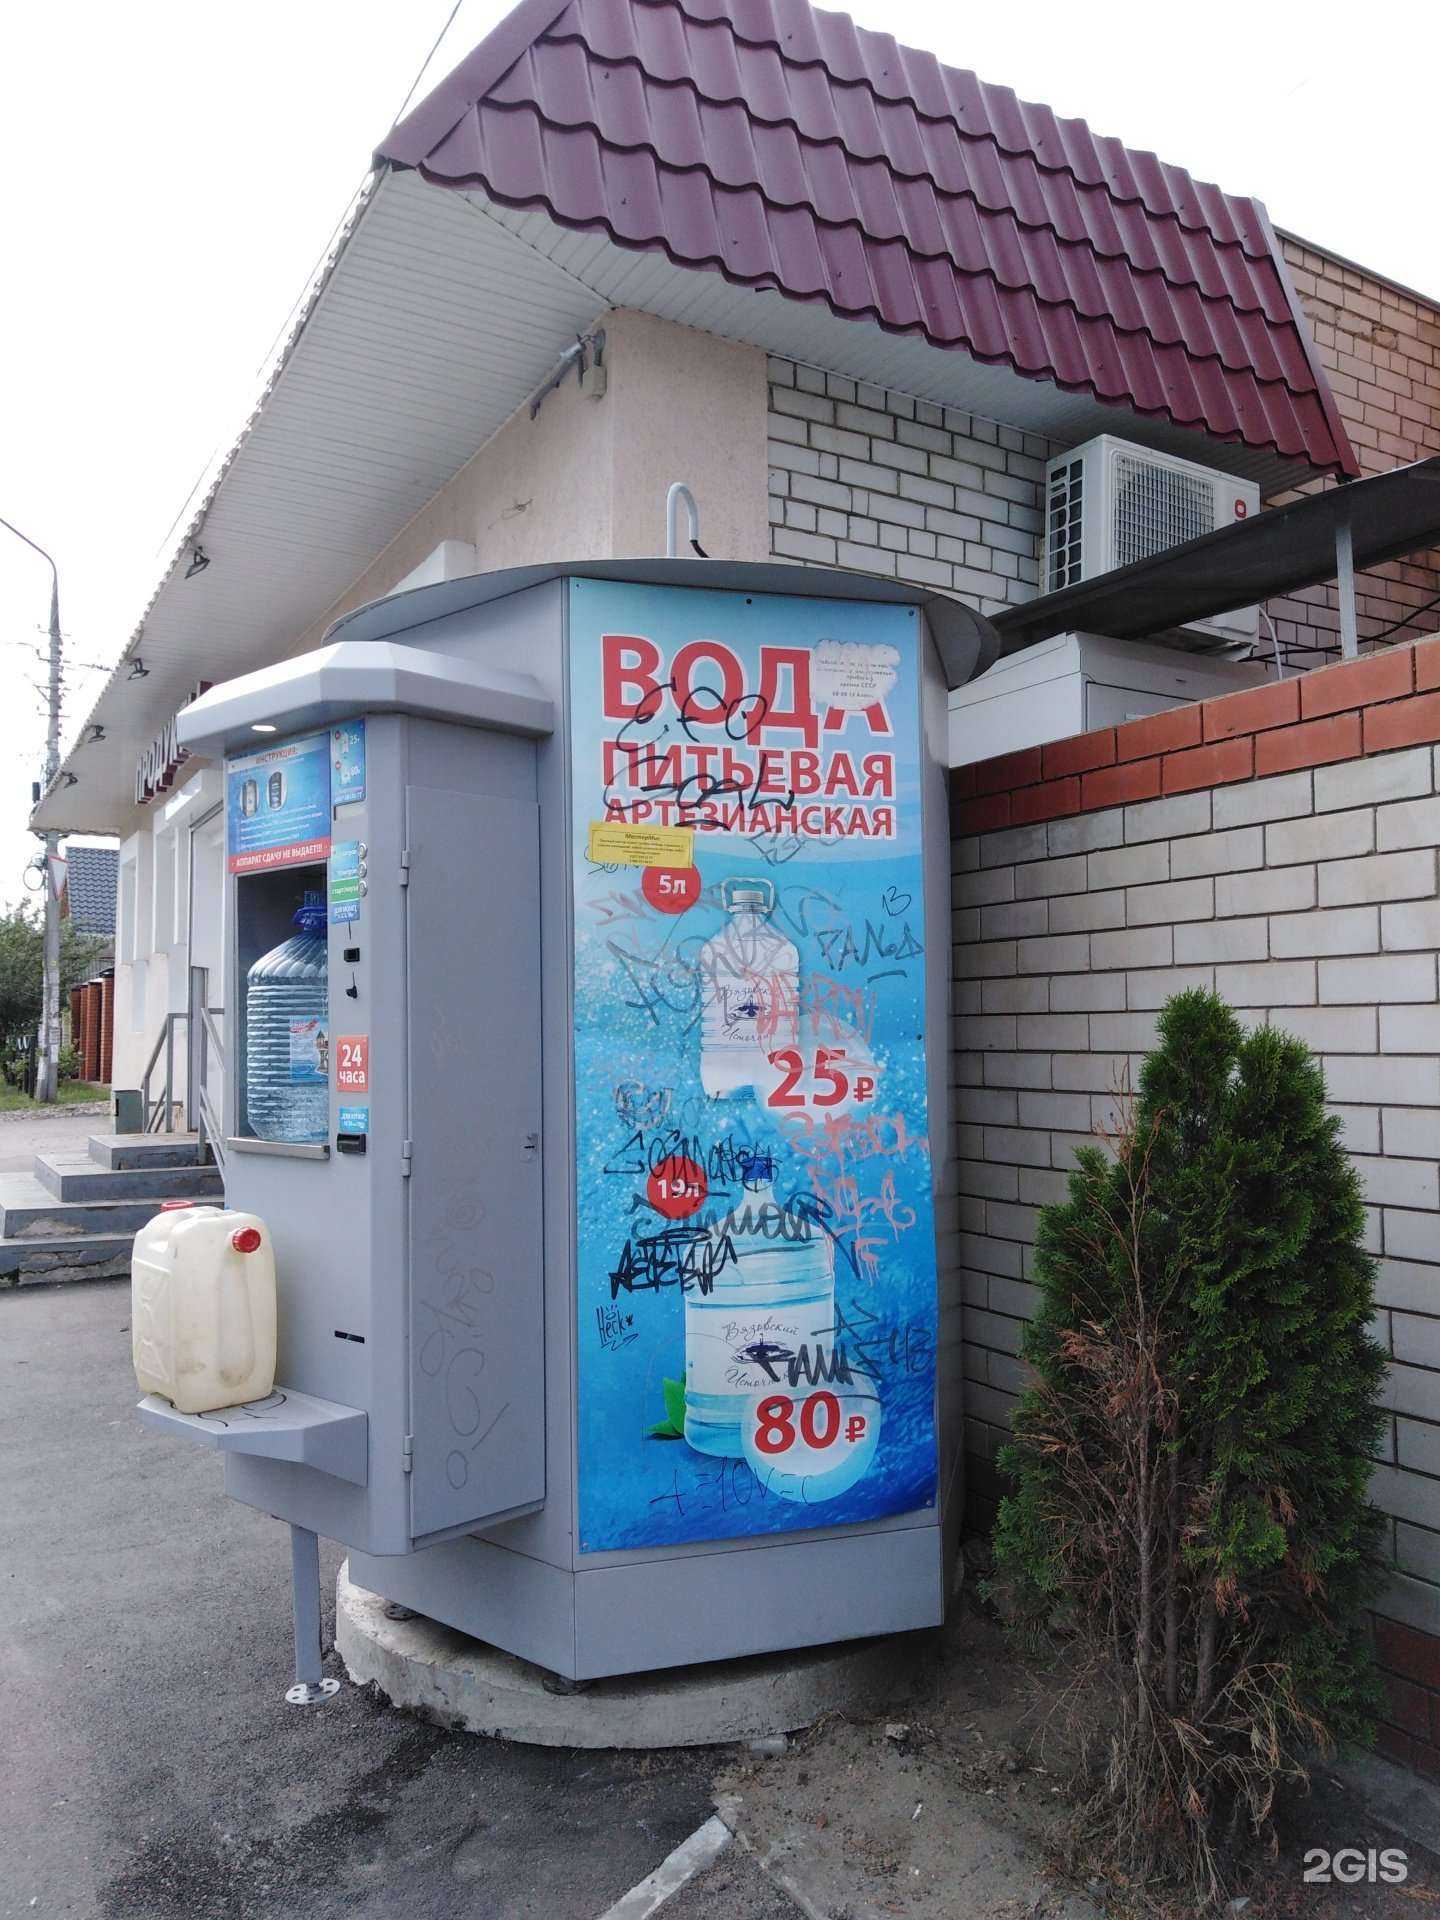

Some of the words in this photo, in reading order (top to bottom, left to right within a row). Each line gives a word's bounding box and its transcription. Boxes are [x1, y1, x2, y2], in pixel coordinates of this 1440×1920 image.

[602, 741, 892, 796] ПИТЬЕВАЯ
[604, 798, 892, 836] АРТЕЗИАНСКАЯ
[262, 851, 281, 863] СДАЧУ
[283, 849, 291, 858] НЕ
[659, 875, 686, 894] 5л
[342, 1044, 362, 1067] 24
[340, 1070, 366, 1084] часа
